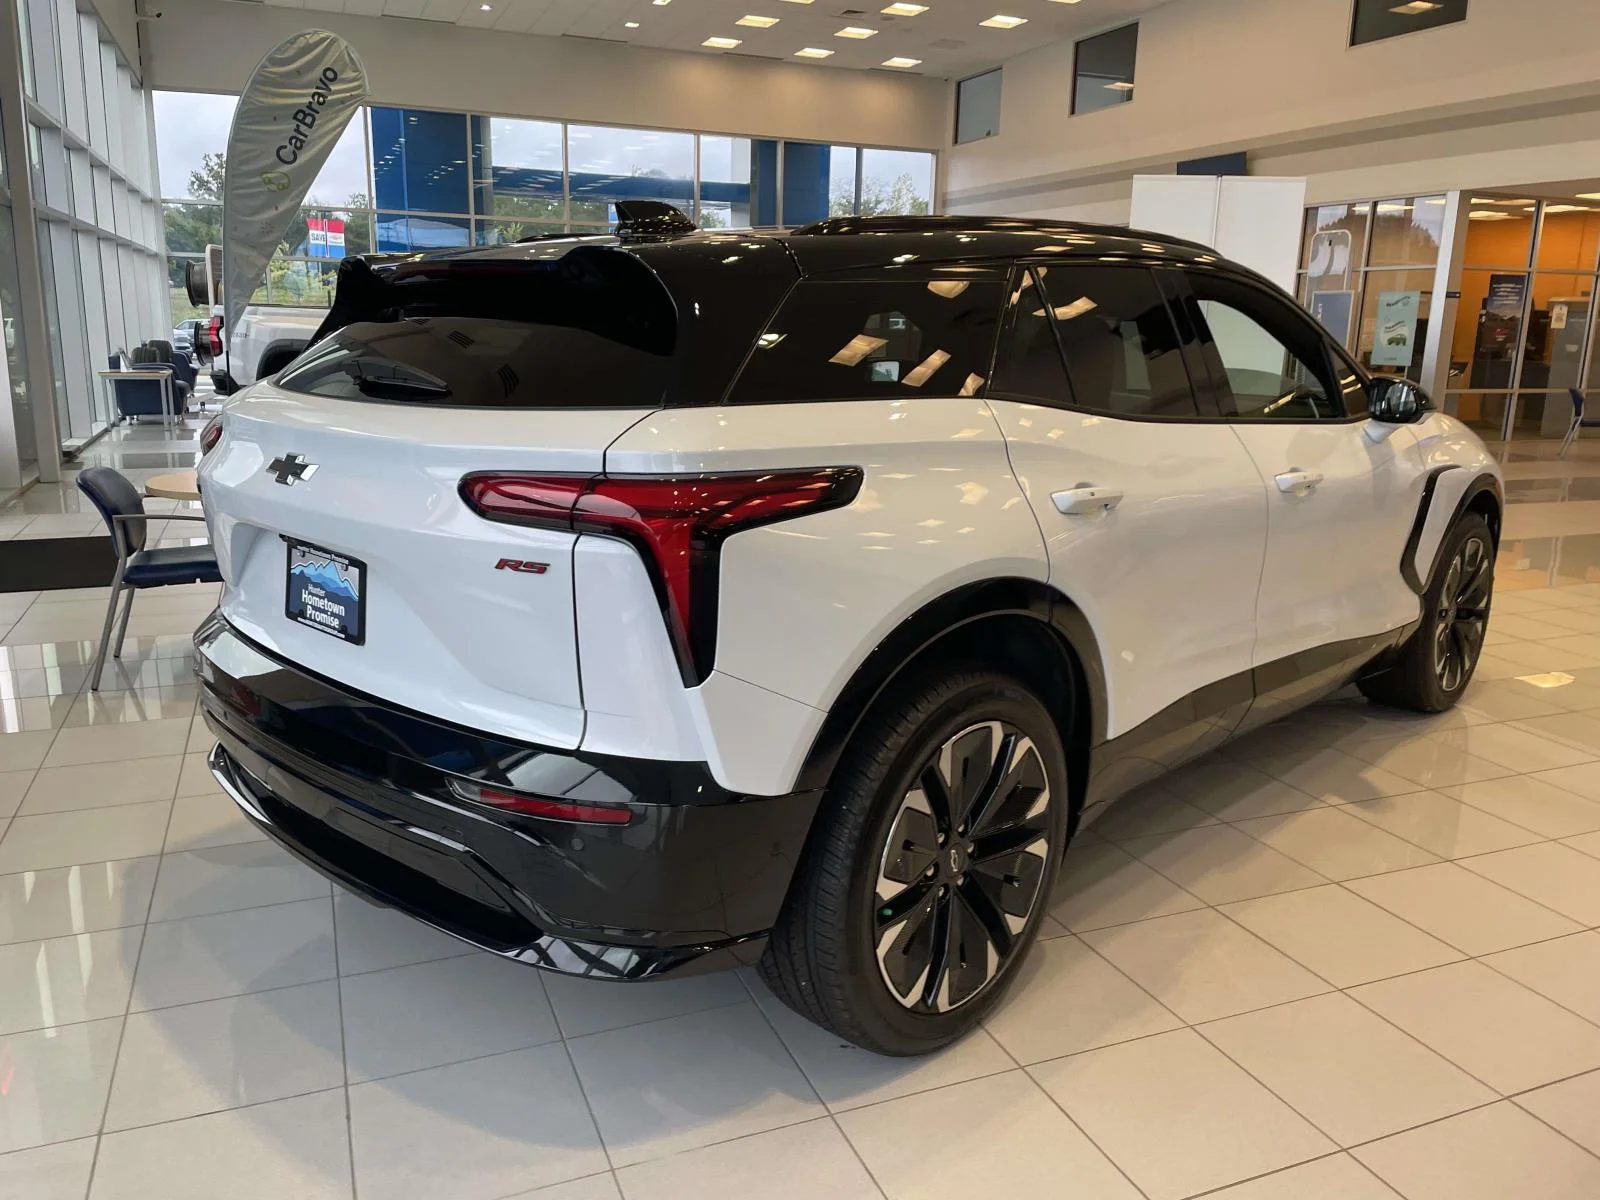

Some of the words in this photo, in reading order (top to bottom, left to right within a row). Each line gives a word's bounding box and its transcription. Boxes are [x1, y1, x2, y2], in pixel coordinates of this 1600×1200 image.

[276, 67, 338, 165] CarBravo
[311, 232, 326, 242] SAVE
[495, 558, 551, 574] RS
[308, 583, 326, 597] Hunter
[302, 589, 345, 617] Hometown
[306, 604, 340, 629] Promise
